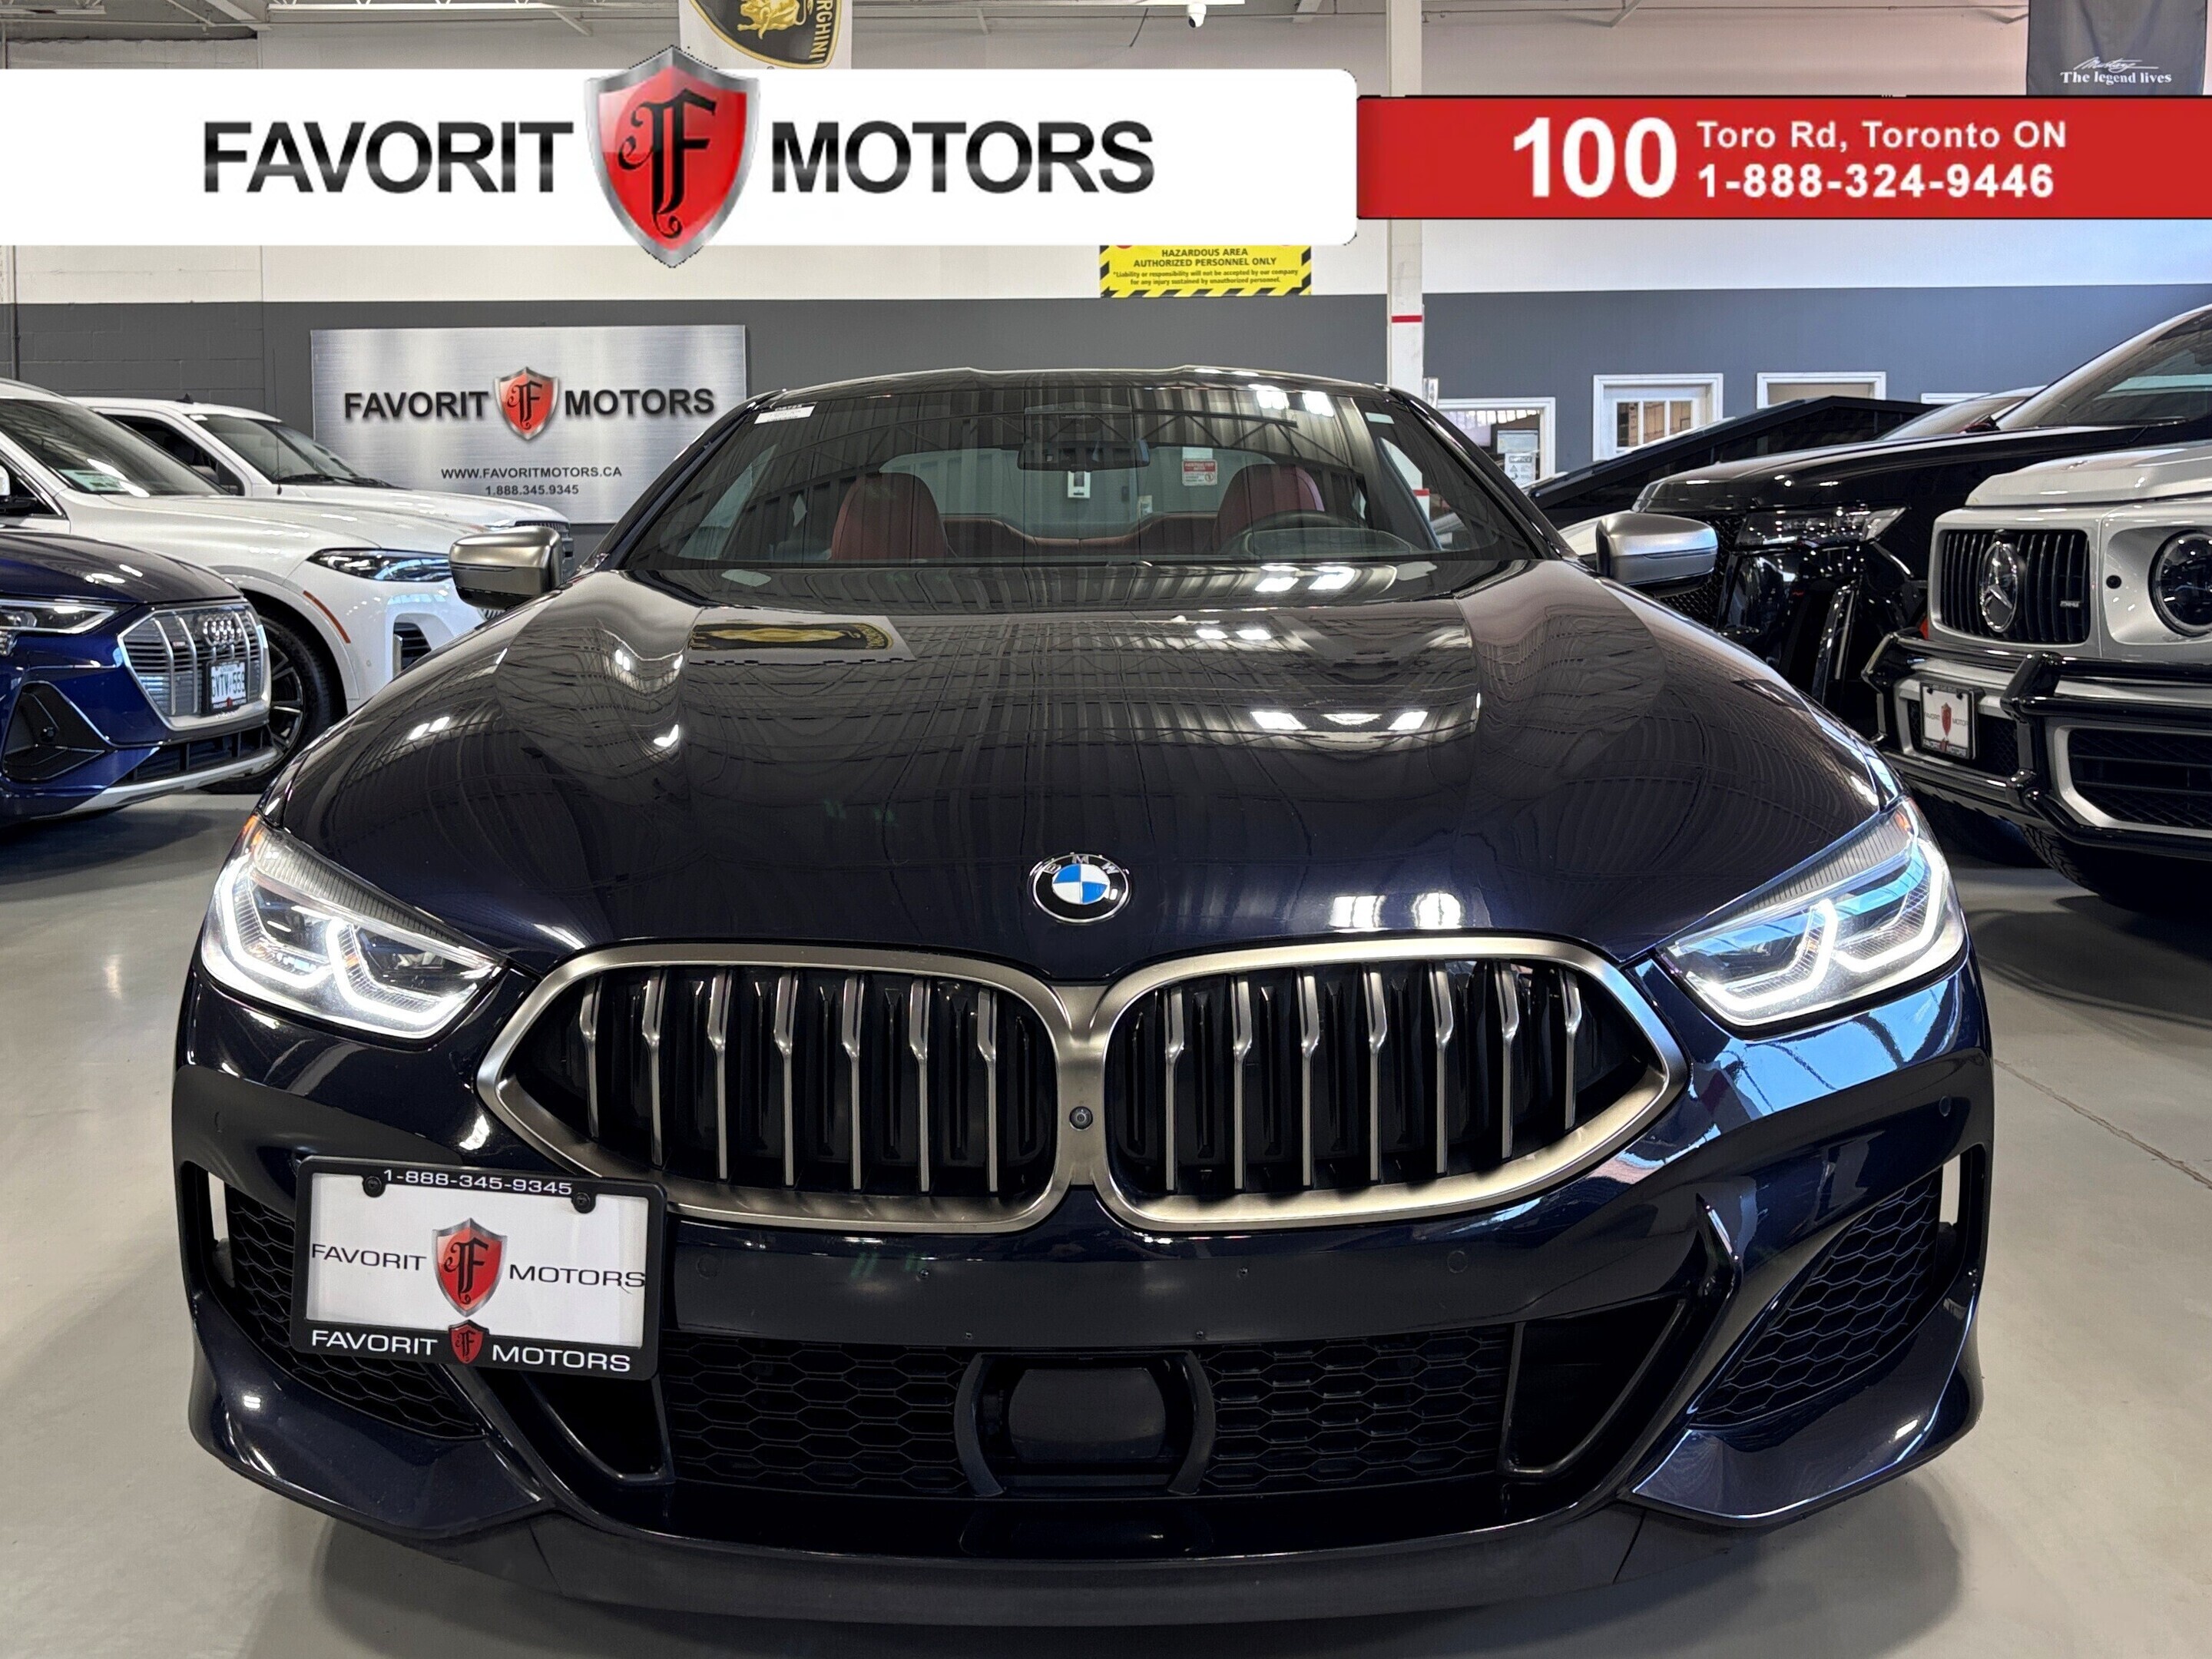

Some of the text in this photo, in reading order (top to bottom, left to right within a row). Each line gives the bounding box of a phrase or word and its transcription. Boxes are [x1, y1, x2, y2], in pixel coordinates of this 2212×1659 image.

[2060, 71, 2172, 86] The legend lives
[1161, 248, 1248, 257] HAZARDOUS AREA
[1133, 257, 1277, 267] AUTHORIZED PERSONNEL ONLY
[1149, 270, 1189, 279] responsibility
[1223, 269, 1250, 277] accepted
[344, 392, 489, 419] FAVORIT
[565, 388, 716, 418] MOTORS
[441, 467, 622, 479] WWW.FAVORITMOTORS.CA
[485, 485, 579, 496] 1.888.345.9345
[1041, 854, 1120, 875] BMW
[383, 1169, 573, 1195] 1-888-345-9345
[311, 1243, 427, 1271] FAVORIT
[508, 1263, 647, 1288] MOTORS
[312, 1329, 439, 1356] FAVORIT
[492, 1344, 631, 1373] MOTORS
